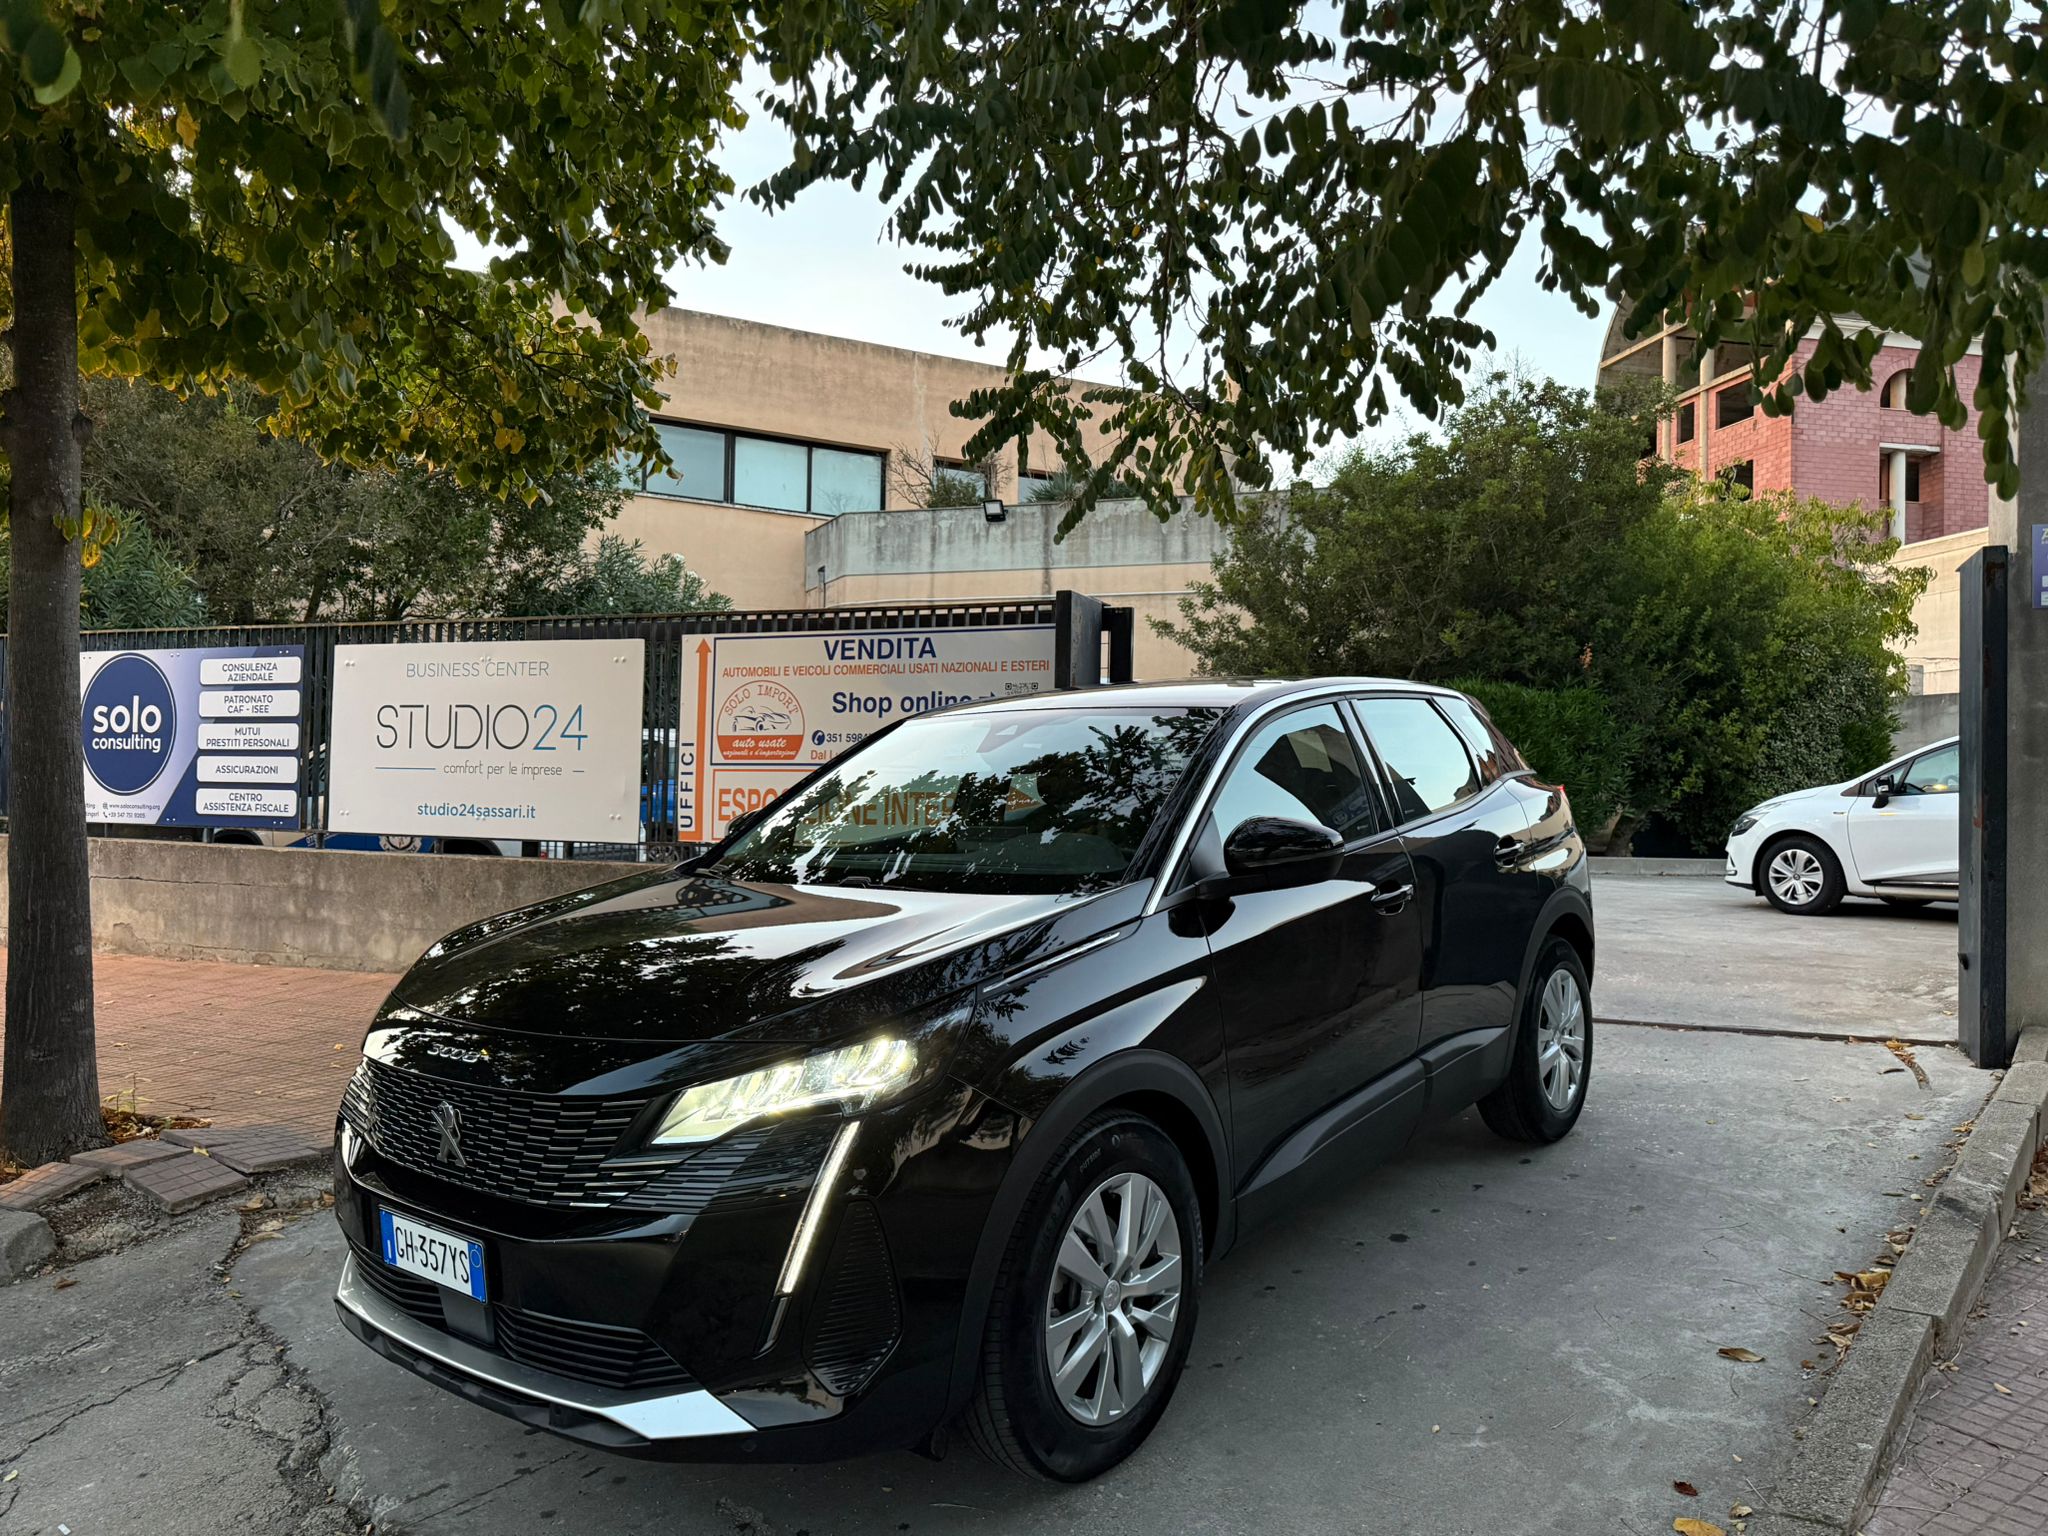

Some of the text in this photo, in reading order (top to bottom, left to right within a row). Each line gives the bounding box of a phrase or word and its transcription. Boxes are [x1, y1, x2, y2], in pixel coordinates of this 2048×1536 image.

[824, 637, 937, 660] VENDITA
[222, 662, 278, 673] CONSULENZA
[406, 661, 549, 678] BUSINESS CENTER
[722, 660, 1050, 678] AUTOMOBILI E VEICOLI COMMERCIALI USATI NAZIONALI E ESTERI
[227, 672, 274, 682] AZIENDALE
[224, 694, 274, 705] PATRONATO
[724, 684, 799, 716] SOLO IMPORT
[832, 691, 892, 718] Shop
[93, 695, 162, 734] solo
[227, 704, 244, 714] CAF
[251, 704, 270, 714] ISEE
[234, 727, 261, 737] MUTUI
[376, 703, 588, 751] STUDIO24
[92, 734, 161, 753] consulting
[206, 738, 290, 748] PRESTITI PERSONALI
[732, 738, 788, 749] auto usate
[826, 733, 842, 743] 351
[810, 750, 826, 760] Dal
[215, 765, 279, 774] ASSICURAZIONI
[443, 760, 563, 780] comfort per le imprese
[680, 742, 695, 828] UFFICI
[228, 793, 263, 802] CENTRO
[203, 802, 290, 813] ASSISTENZA FISCALE
[417, 803, 536, 819] studio24sassari.it
[426, 1042, 480, 1063] 3008
